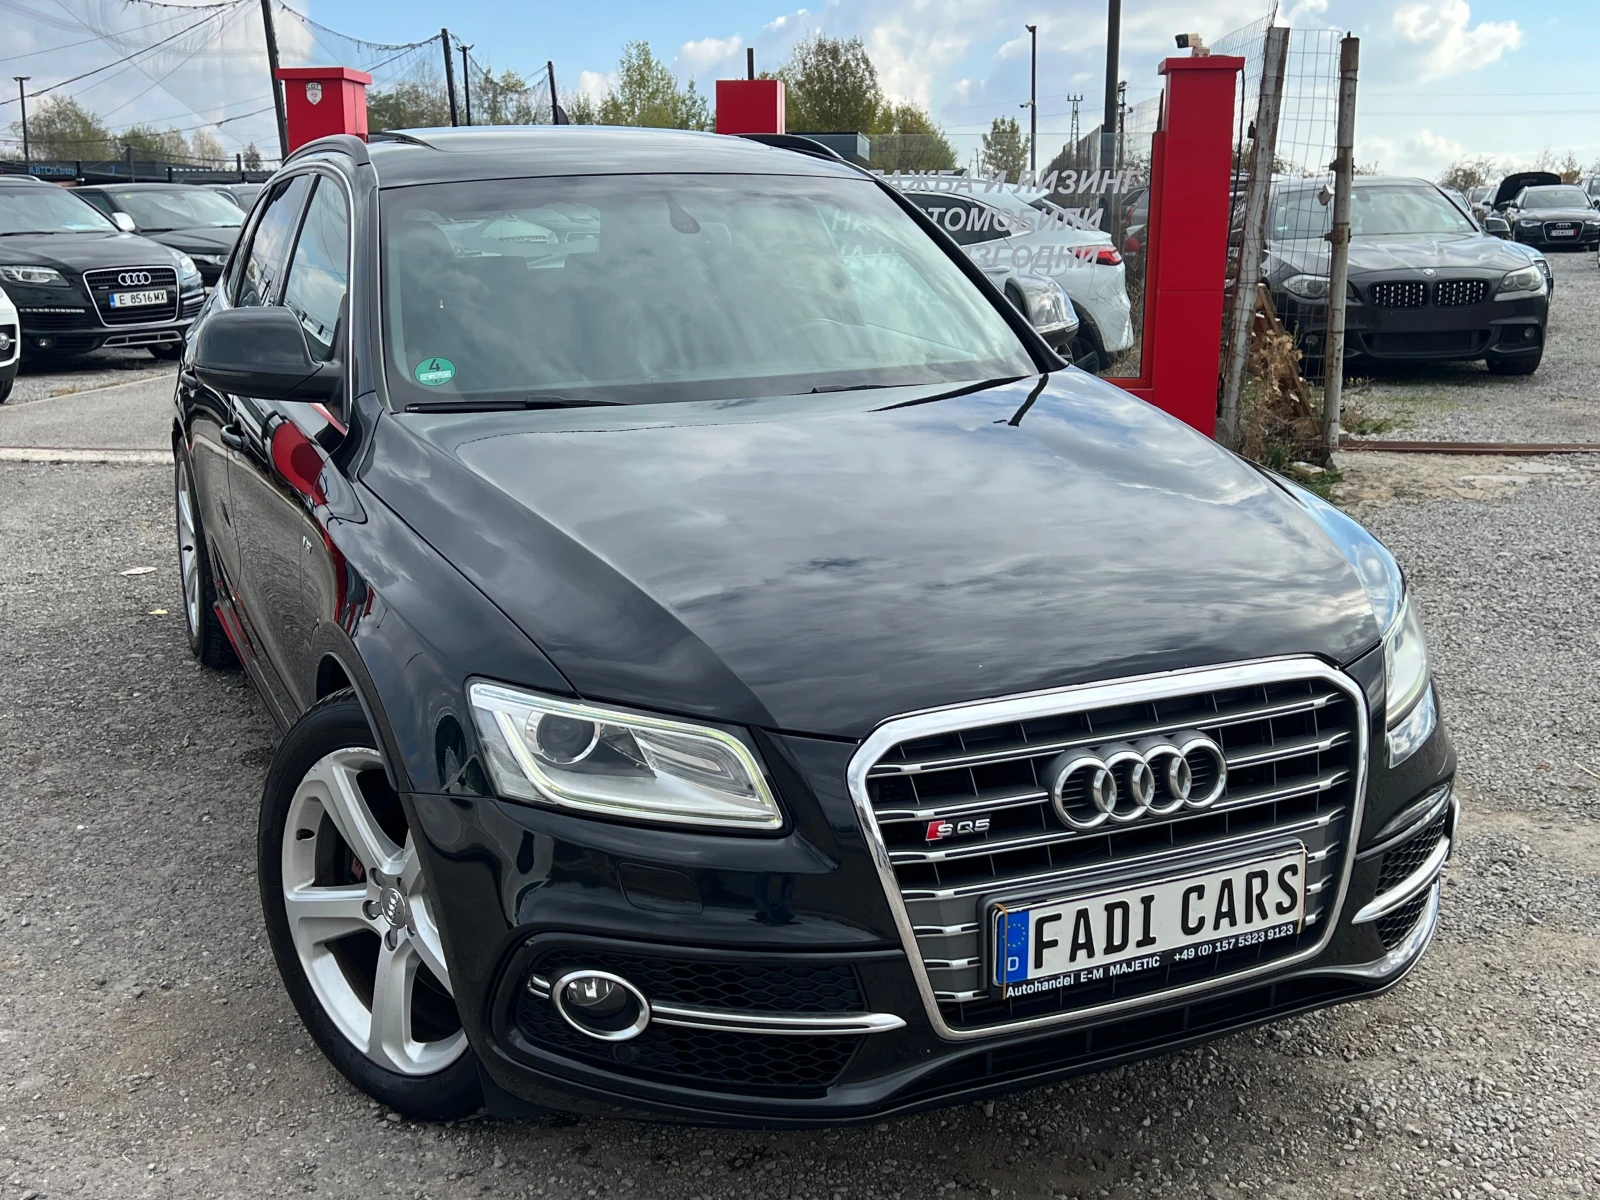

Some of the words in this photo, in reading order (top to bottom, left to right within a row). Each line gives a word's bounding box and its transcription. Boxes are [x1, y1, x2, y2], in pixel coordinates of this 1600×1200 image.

[984, 170, 1007, 193] И
[1013, 169, 1144, 194] ЛИЗИНГ
[919, 207, 1104, 232] ТОМОБИЛИ
[119, 295, 126, 305] E
[429, 358, 441, 372] 4
[1034, 894, 1157, 970] FADI
[1181, 863, 1299, 936] CARS
[1006, 974, 1074, 998] Autohandel
[1080, 969, 1104, 983] E-M
[1109, 956, 1161, 977] MAJETIC
[1173, 949, 1195, 961] +49
[1198, 944, 1213, 957] (0)
[1215, 939, 1236, 953] 157
[1238, 932, 1266, 947] 5323
[1267, 924, 1294, 940] 9123
[1007, 956, 1019, 972] D
